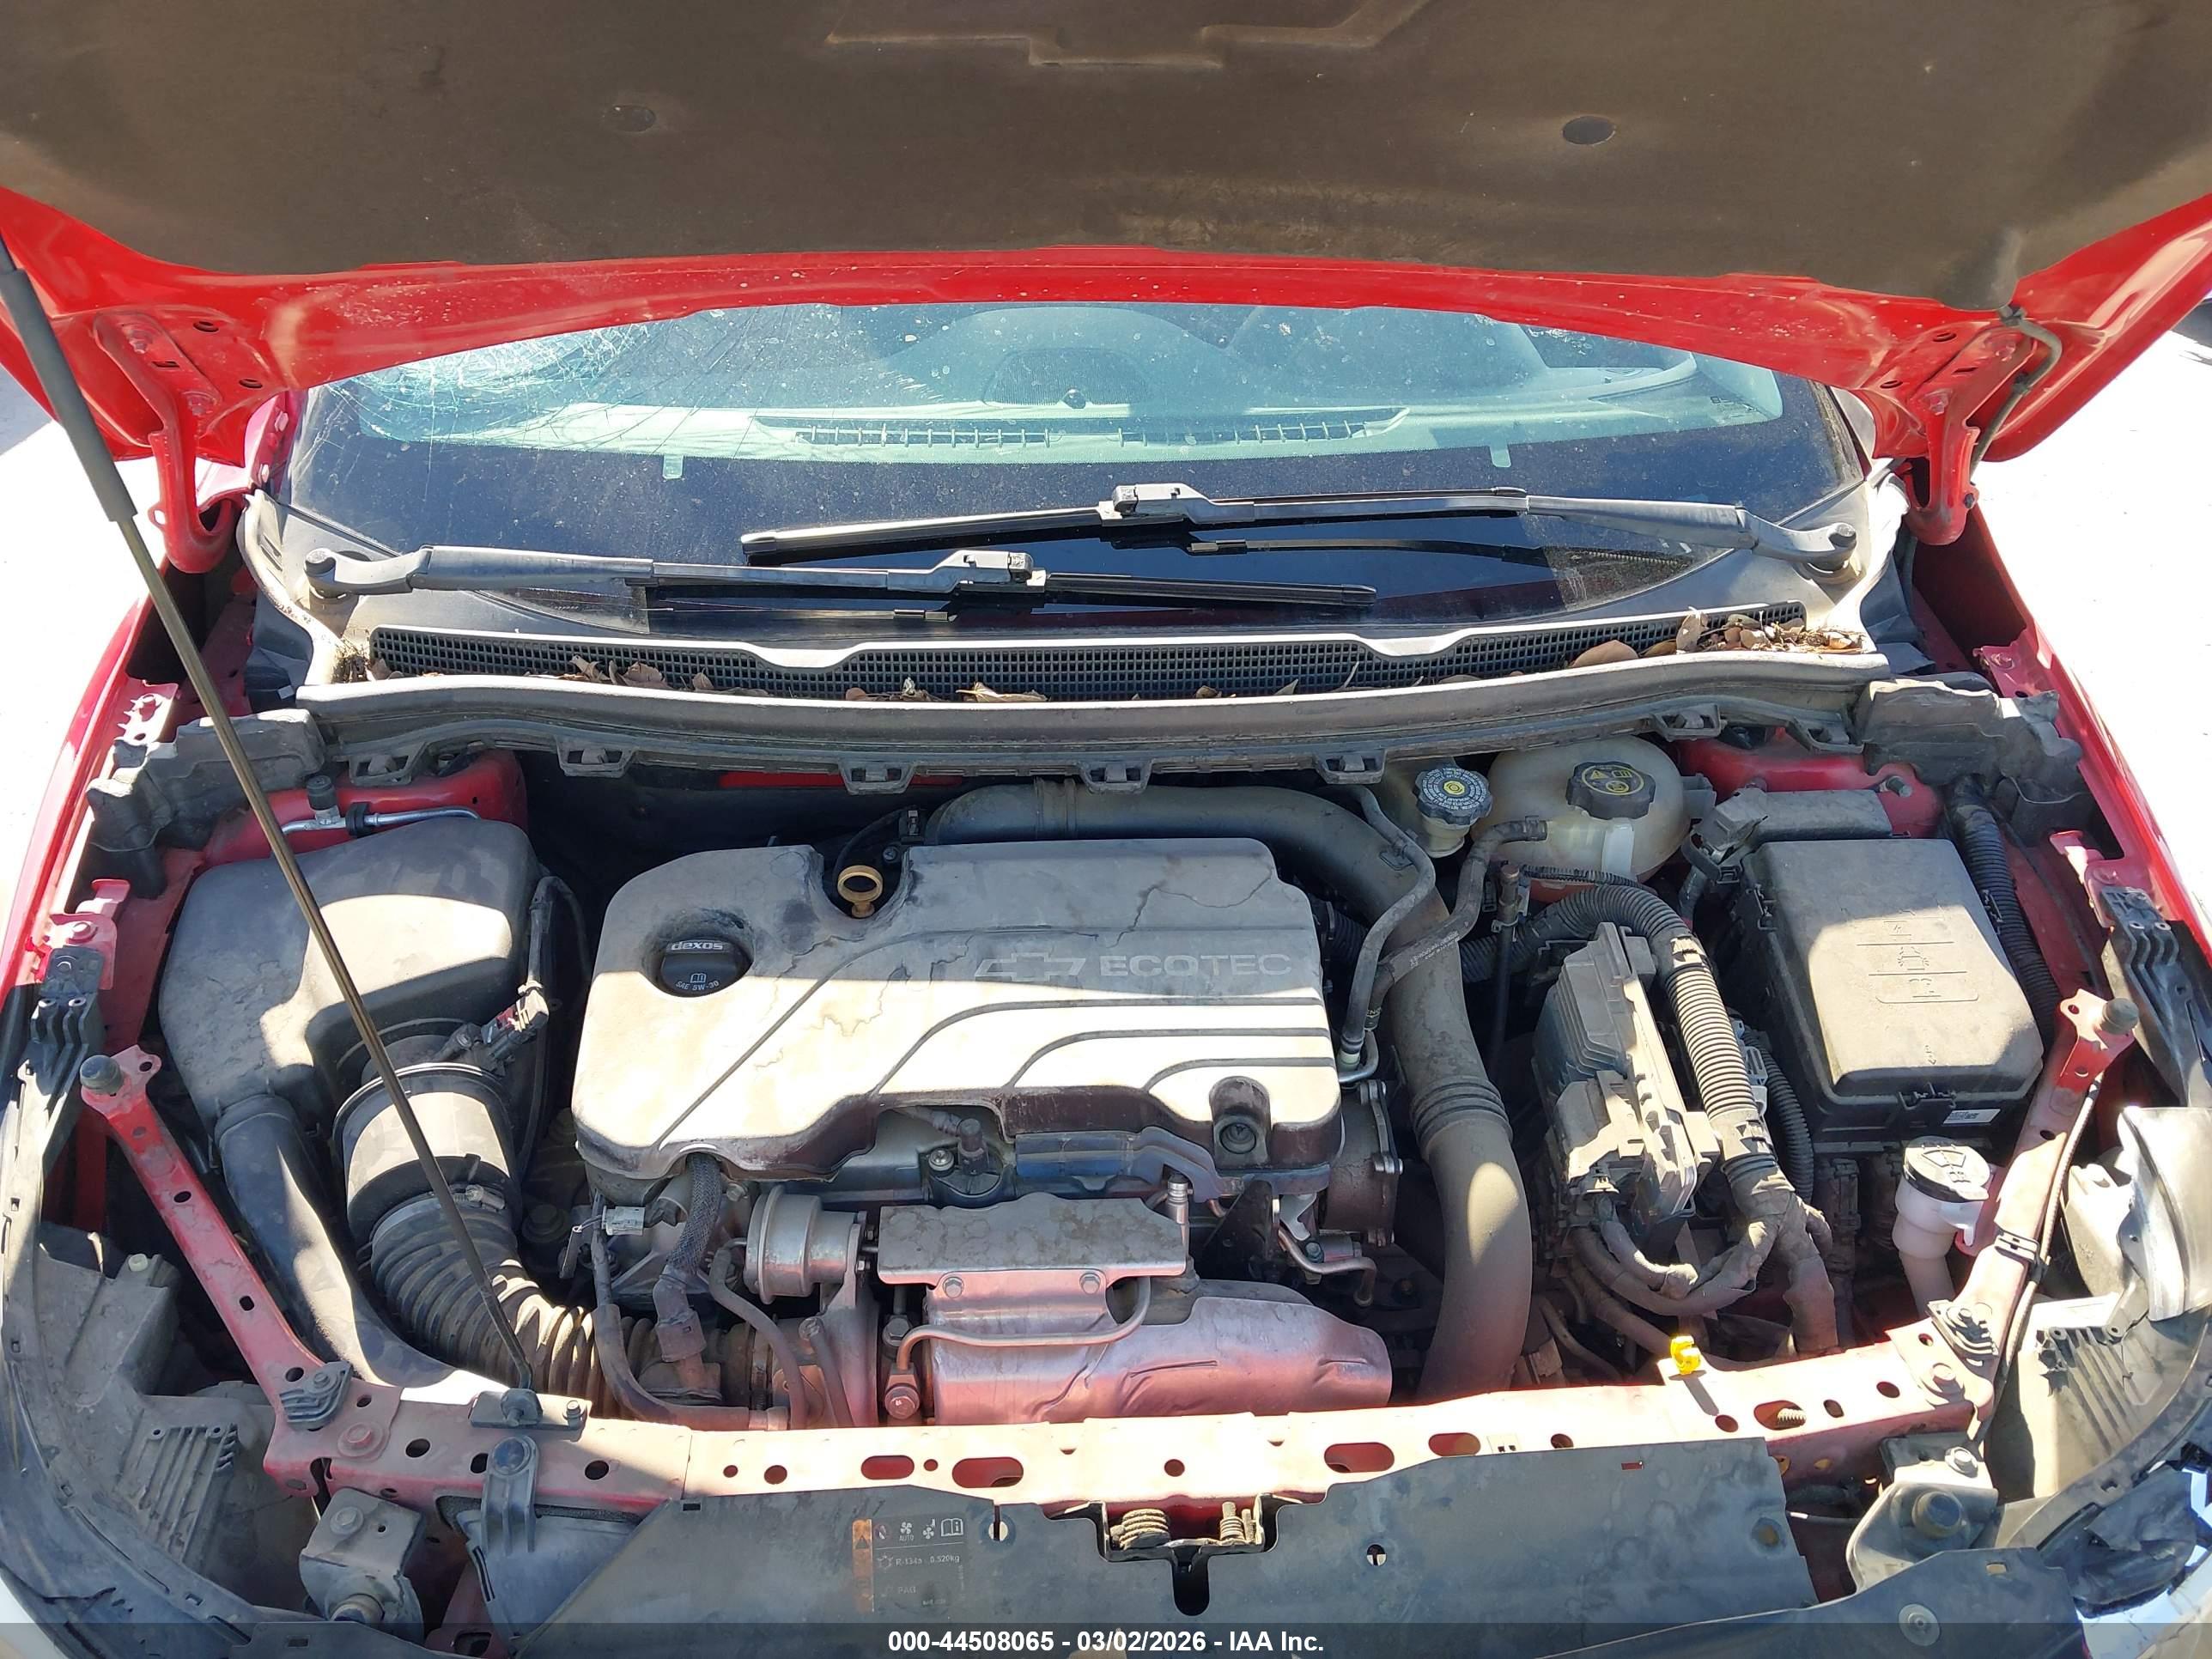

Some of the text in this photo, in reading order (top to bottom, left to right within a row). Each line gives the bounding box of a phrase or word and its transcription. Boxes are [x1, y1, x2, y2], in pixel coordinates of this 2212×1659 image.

[671, 941, 723, 951] dexos
[1100, 953, 1291, 976] ECOTEC
[675, 981, 720, 991] SAE 5W-30
